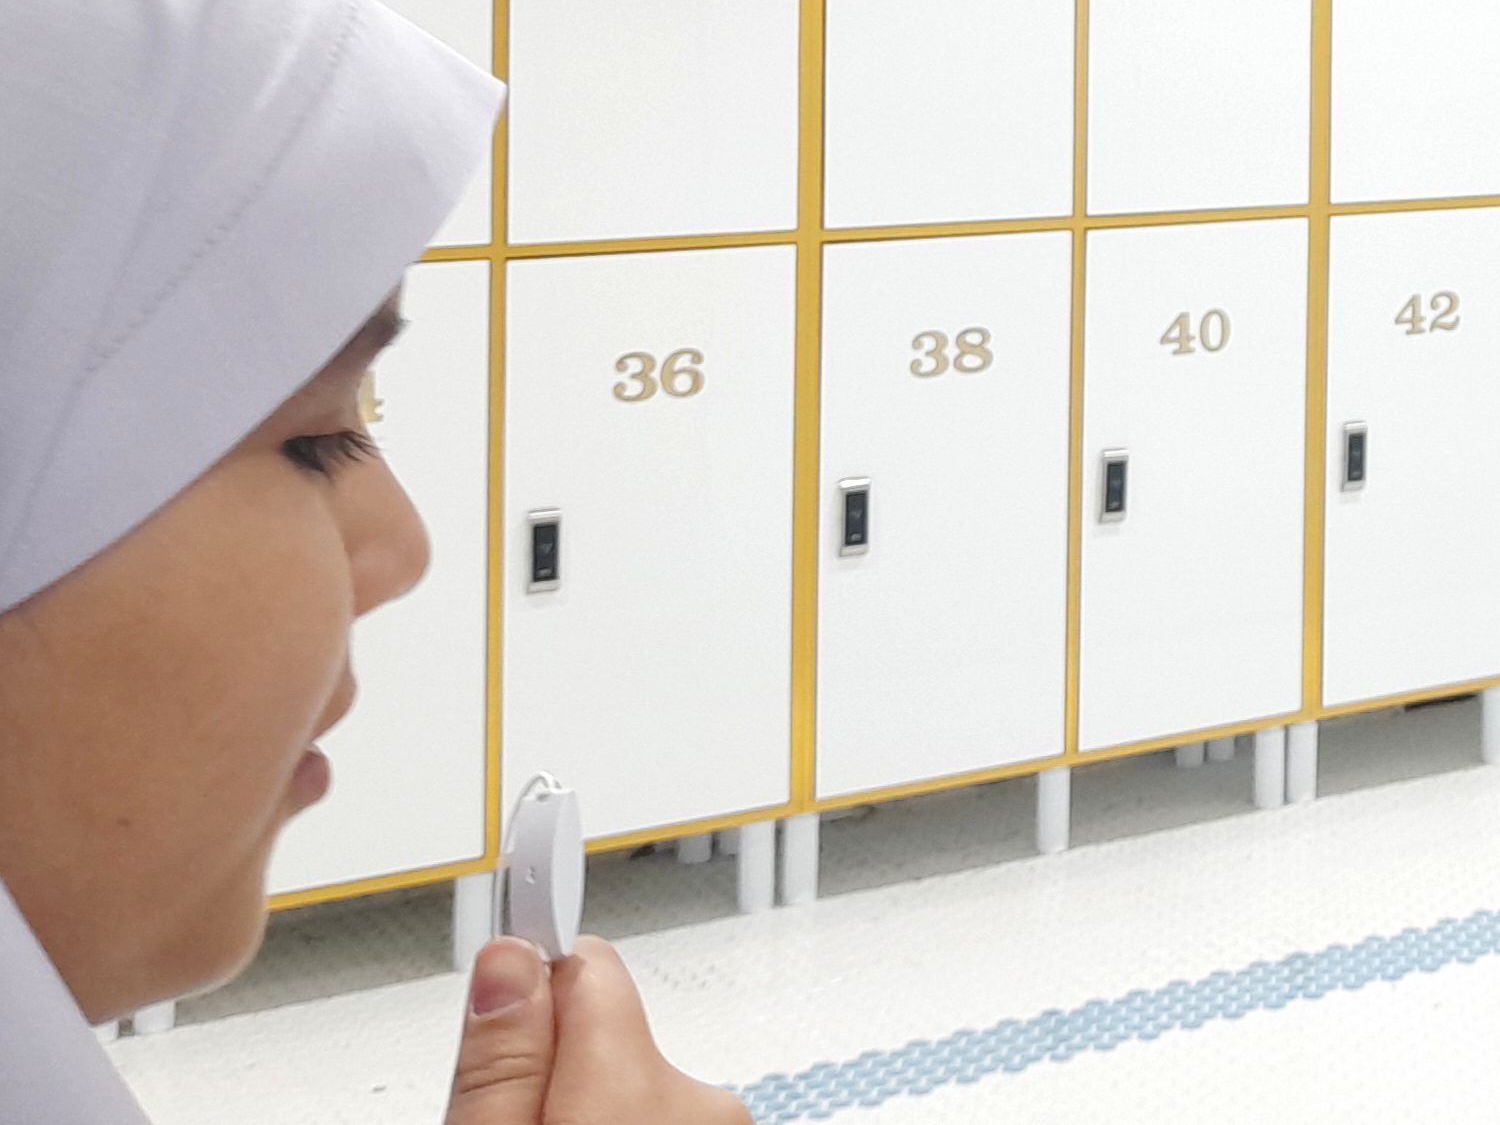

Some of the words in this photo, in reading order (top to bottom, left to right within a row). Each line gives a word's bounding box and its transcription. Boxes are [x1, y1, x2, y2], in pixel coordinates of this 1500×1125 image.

[1159, 308, 1231, 357] 40
[1393, 290, 1461, 336] 42
[611, 347, 705, 404] 36
[909, 326, 994, 380] 38
